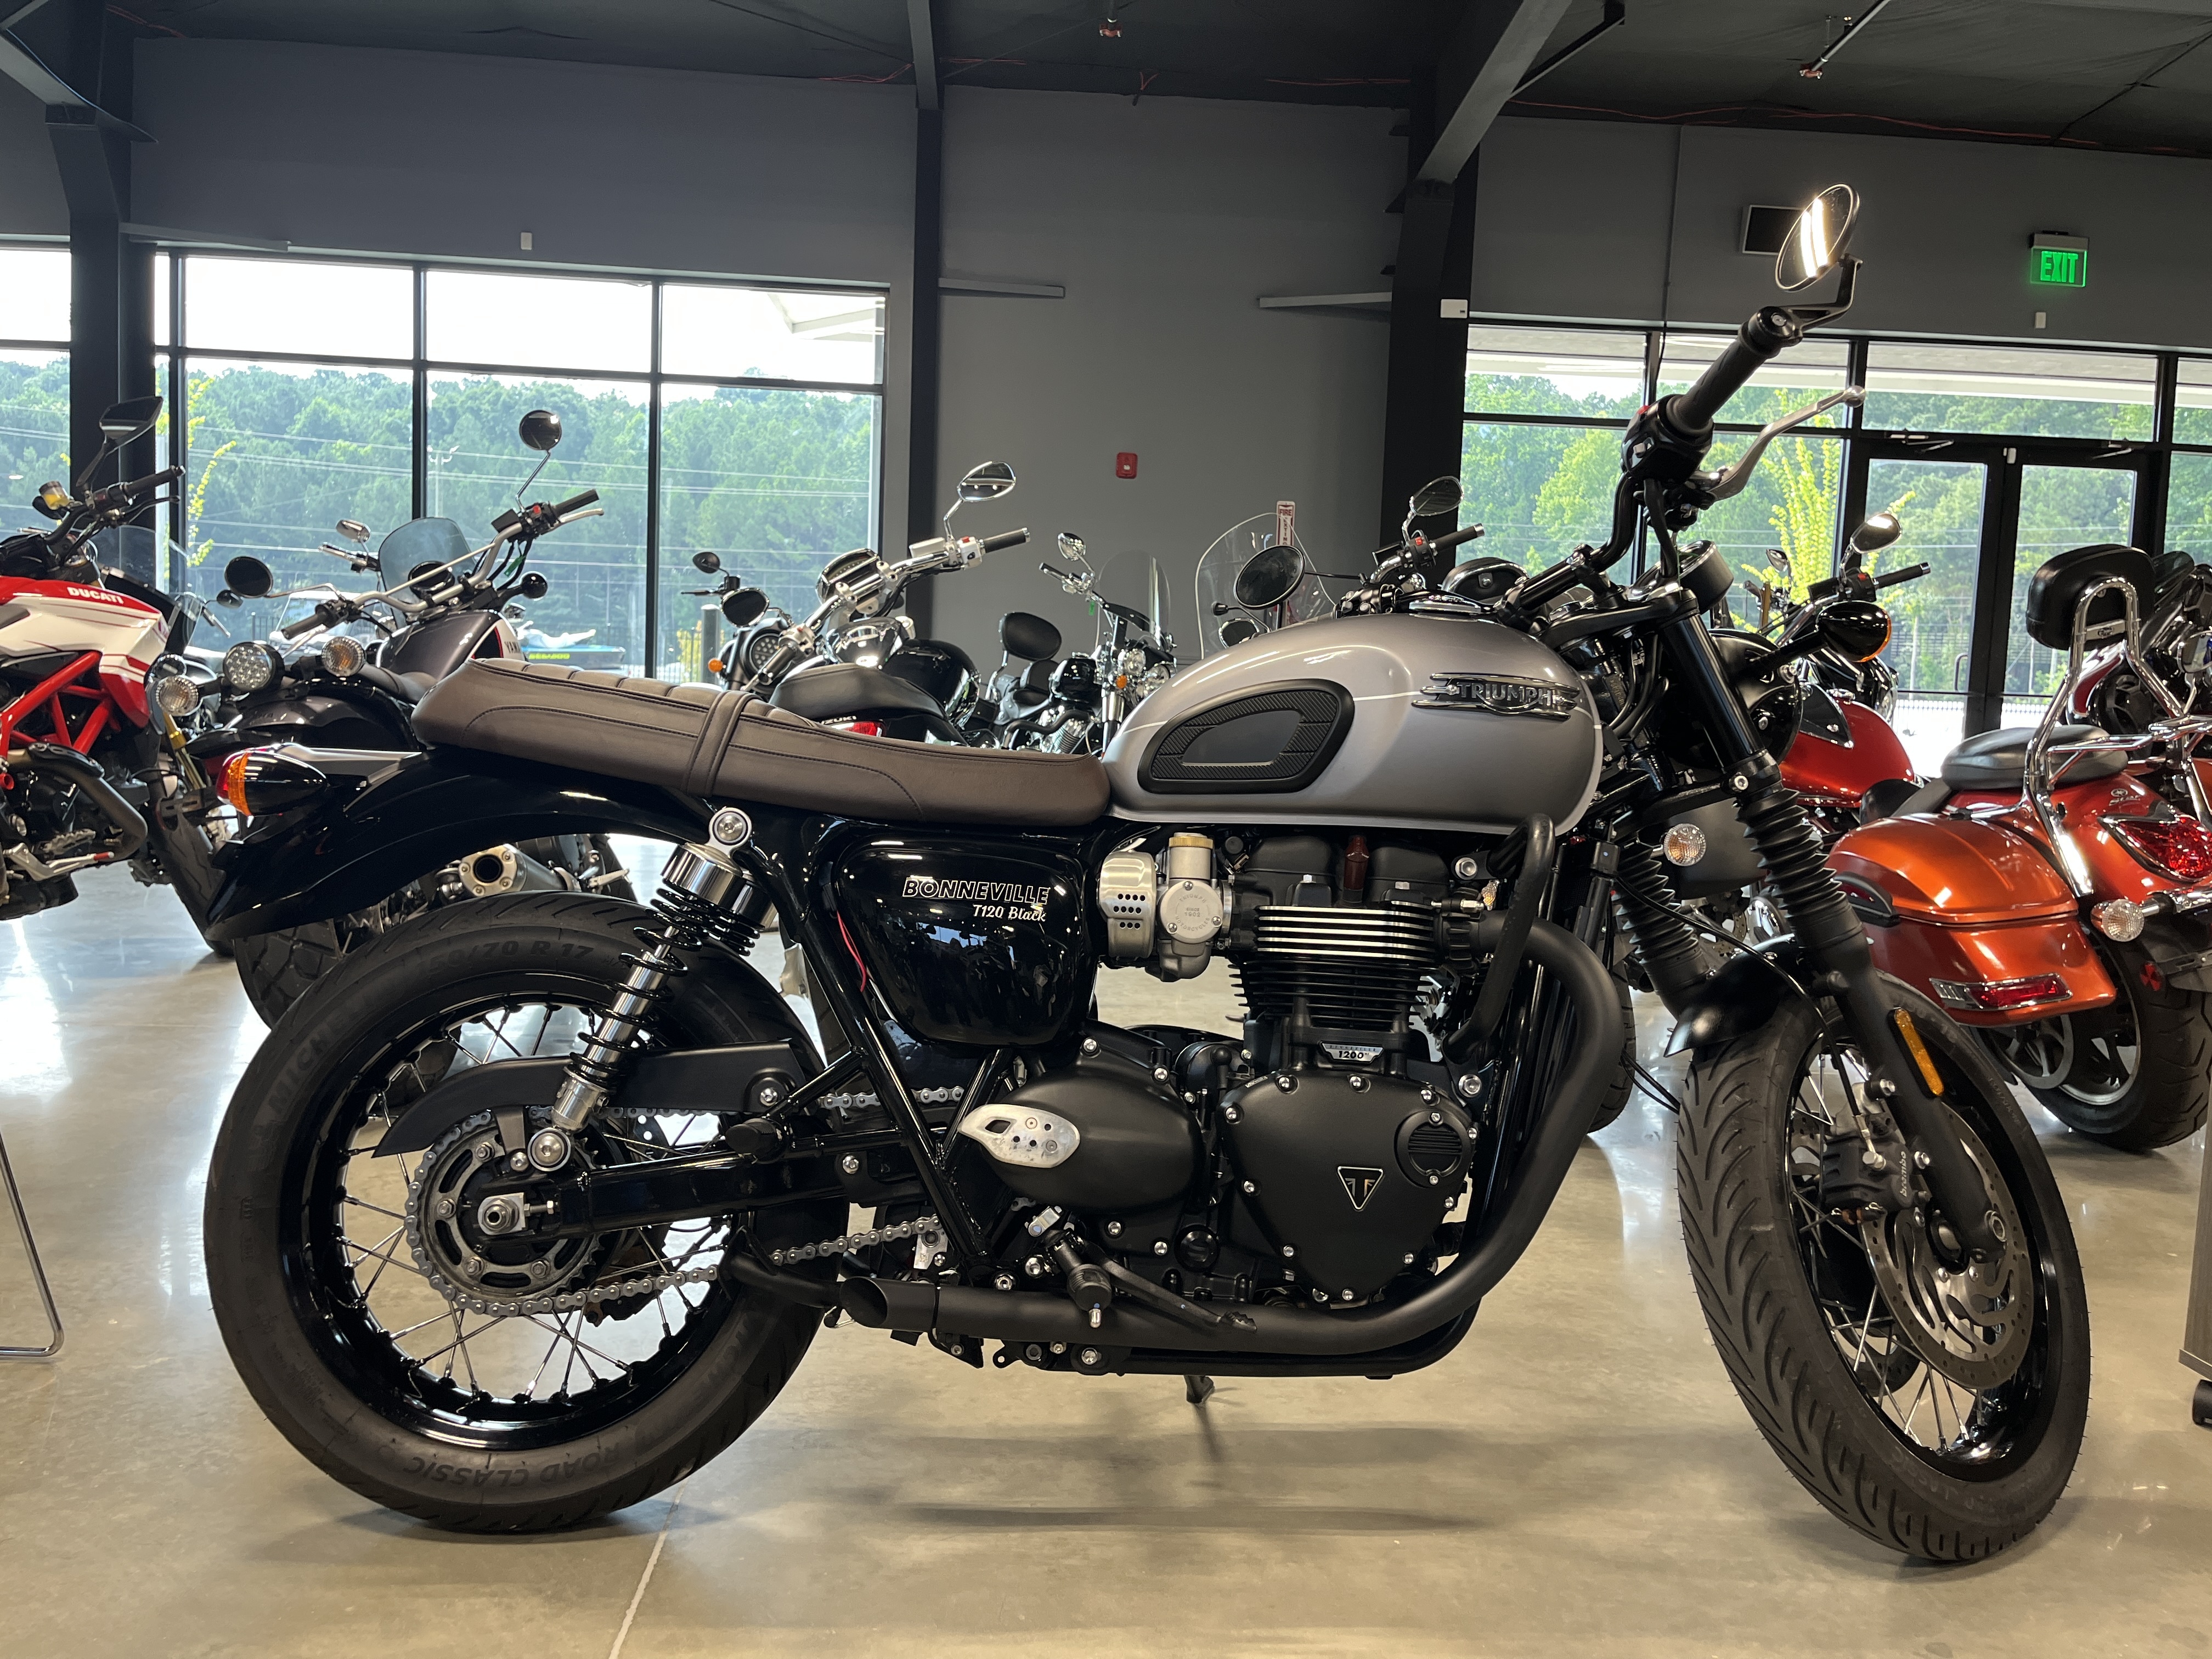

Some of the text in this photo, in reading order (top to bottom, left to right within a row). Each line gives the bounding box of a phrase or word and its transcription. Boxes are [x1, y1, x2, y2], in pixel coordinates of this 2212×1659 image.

[2040, 251, 2079, 283] EXIT
[67, 586, 124, 605] DUCATI
[1457, 681, 1552, 707] TRIUMPH
[902, 878, 1051, 905] BONNEVILLE
[1179, 893, 1207, 904] TRIUMPH
[973, 904, 1046, 922] T120 Black
[1175, 915, 1210, 932] MOTORCYCLES
[529, 940, 551, 956] R
[560, 943, 594, 960] 17
[1339, 1051, 1364, 1059] 1200
[1899, 1151, 1908, 1197] brembo
[403, 1456, 528, 1488] CLASSIC
